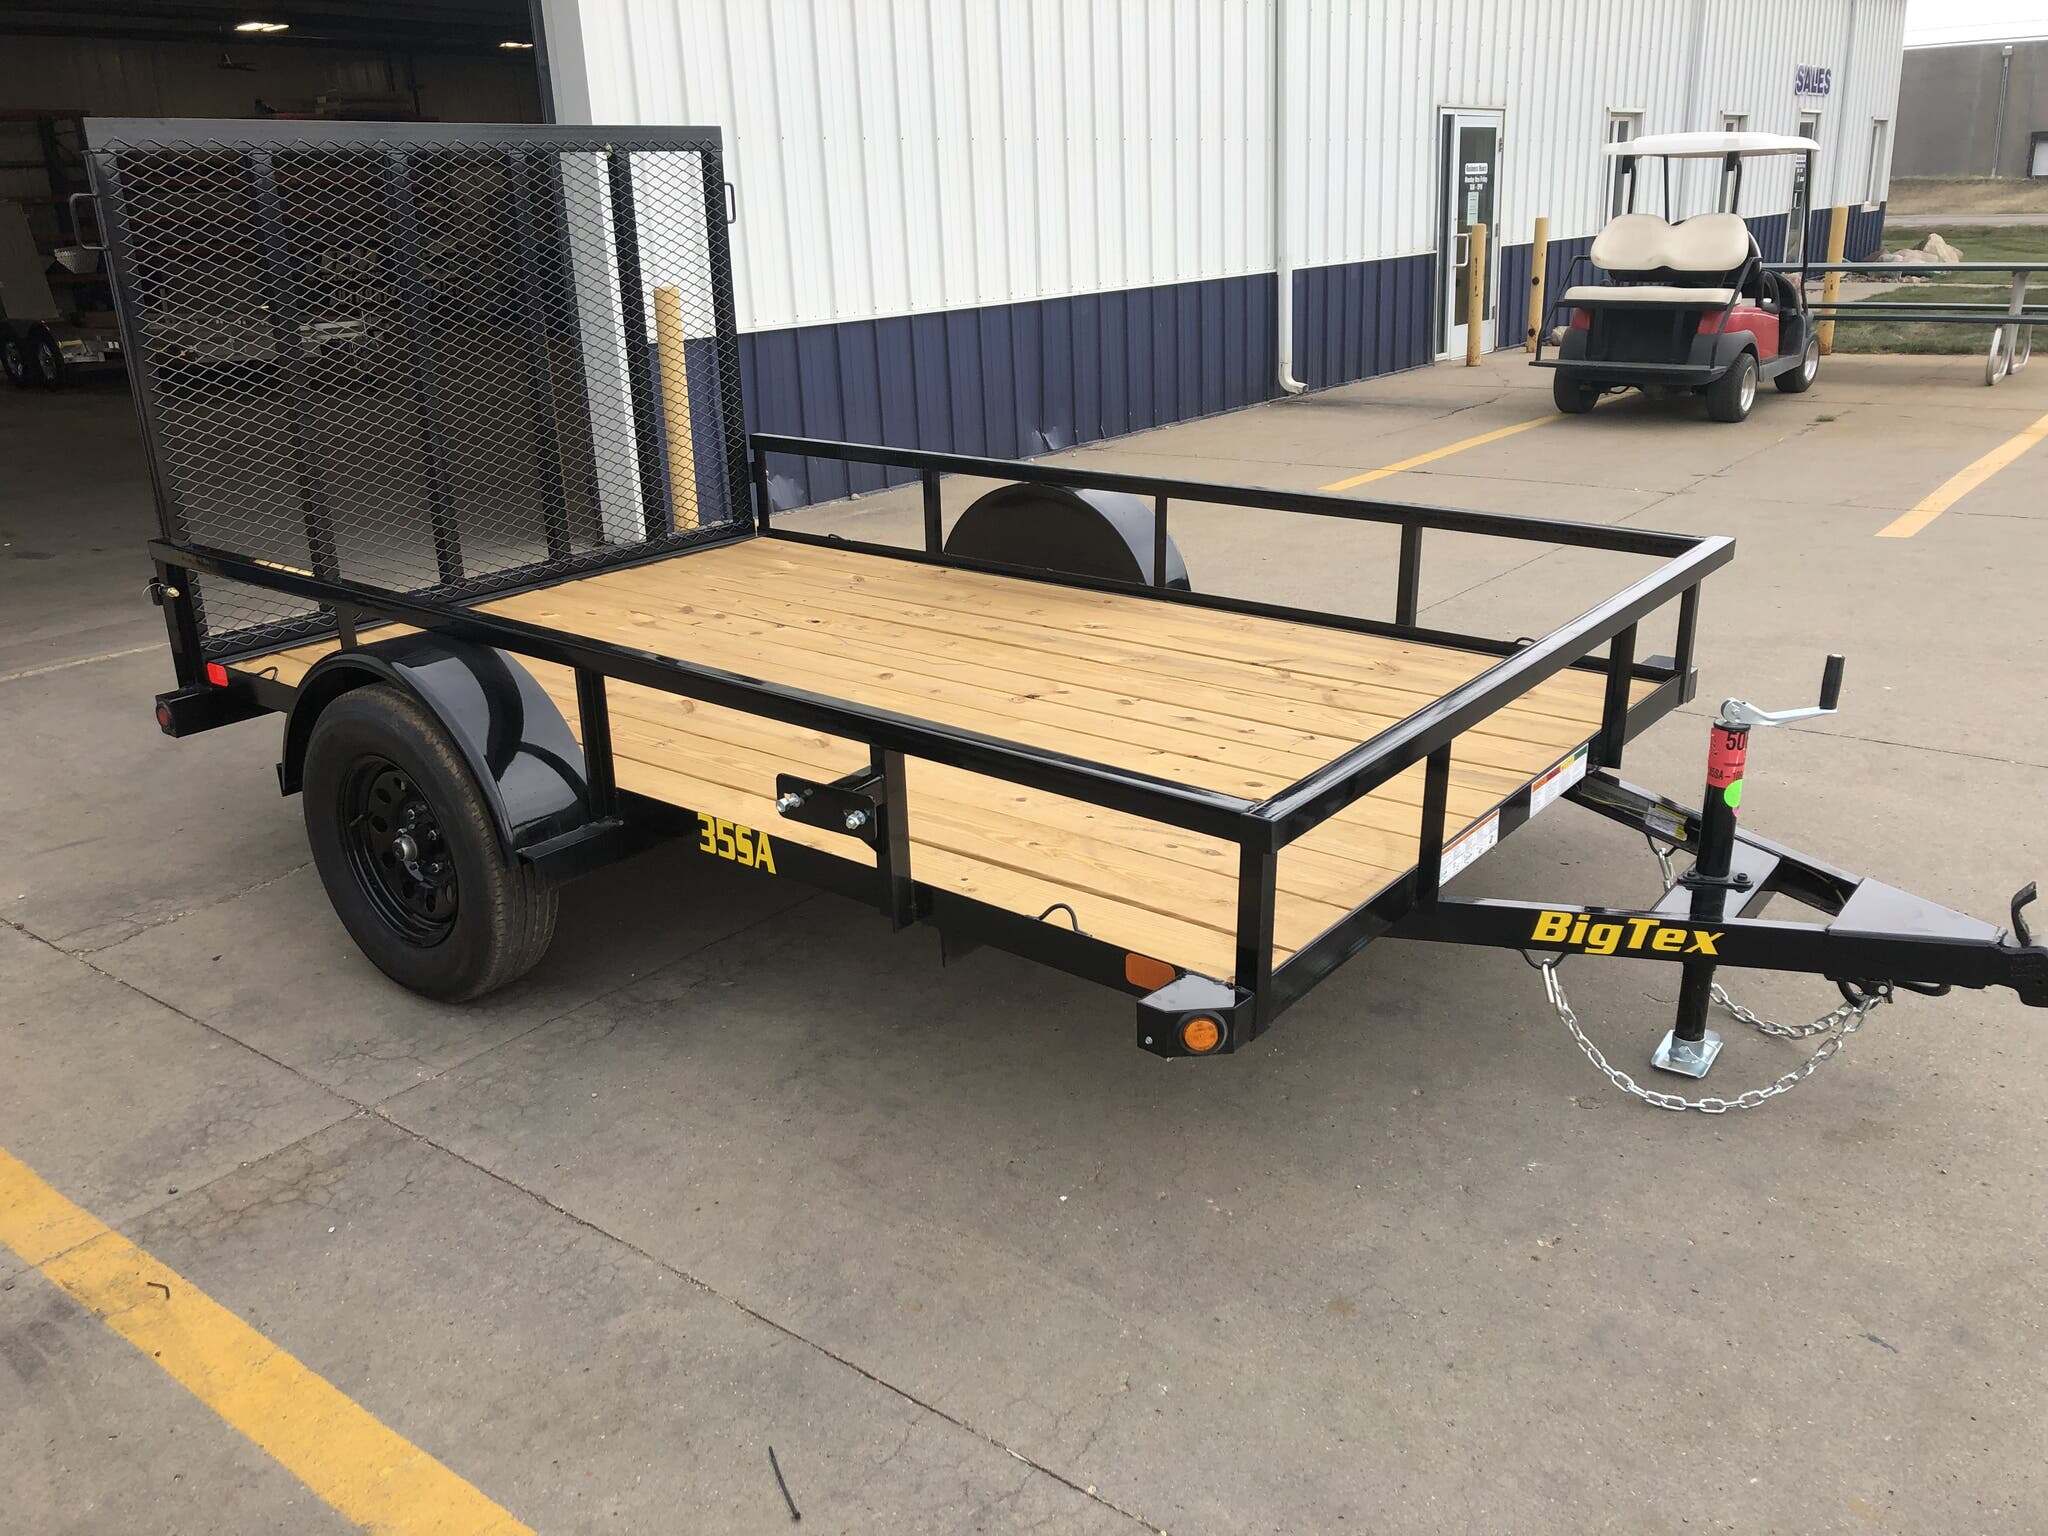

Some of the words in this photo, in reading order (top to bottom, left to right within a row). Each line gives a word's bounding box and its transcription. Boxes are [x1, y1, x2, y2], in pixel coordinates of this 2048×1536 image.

[1796, 65, 1831, 95] SALES
[698, 812, 776, 875] 35SA
[1531, 911, 1725, 955] BigTex
